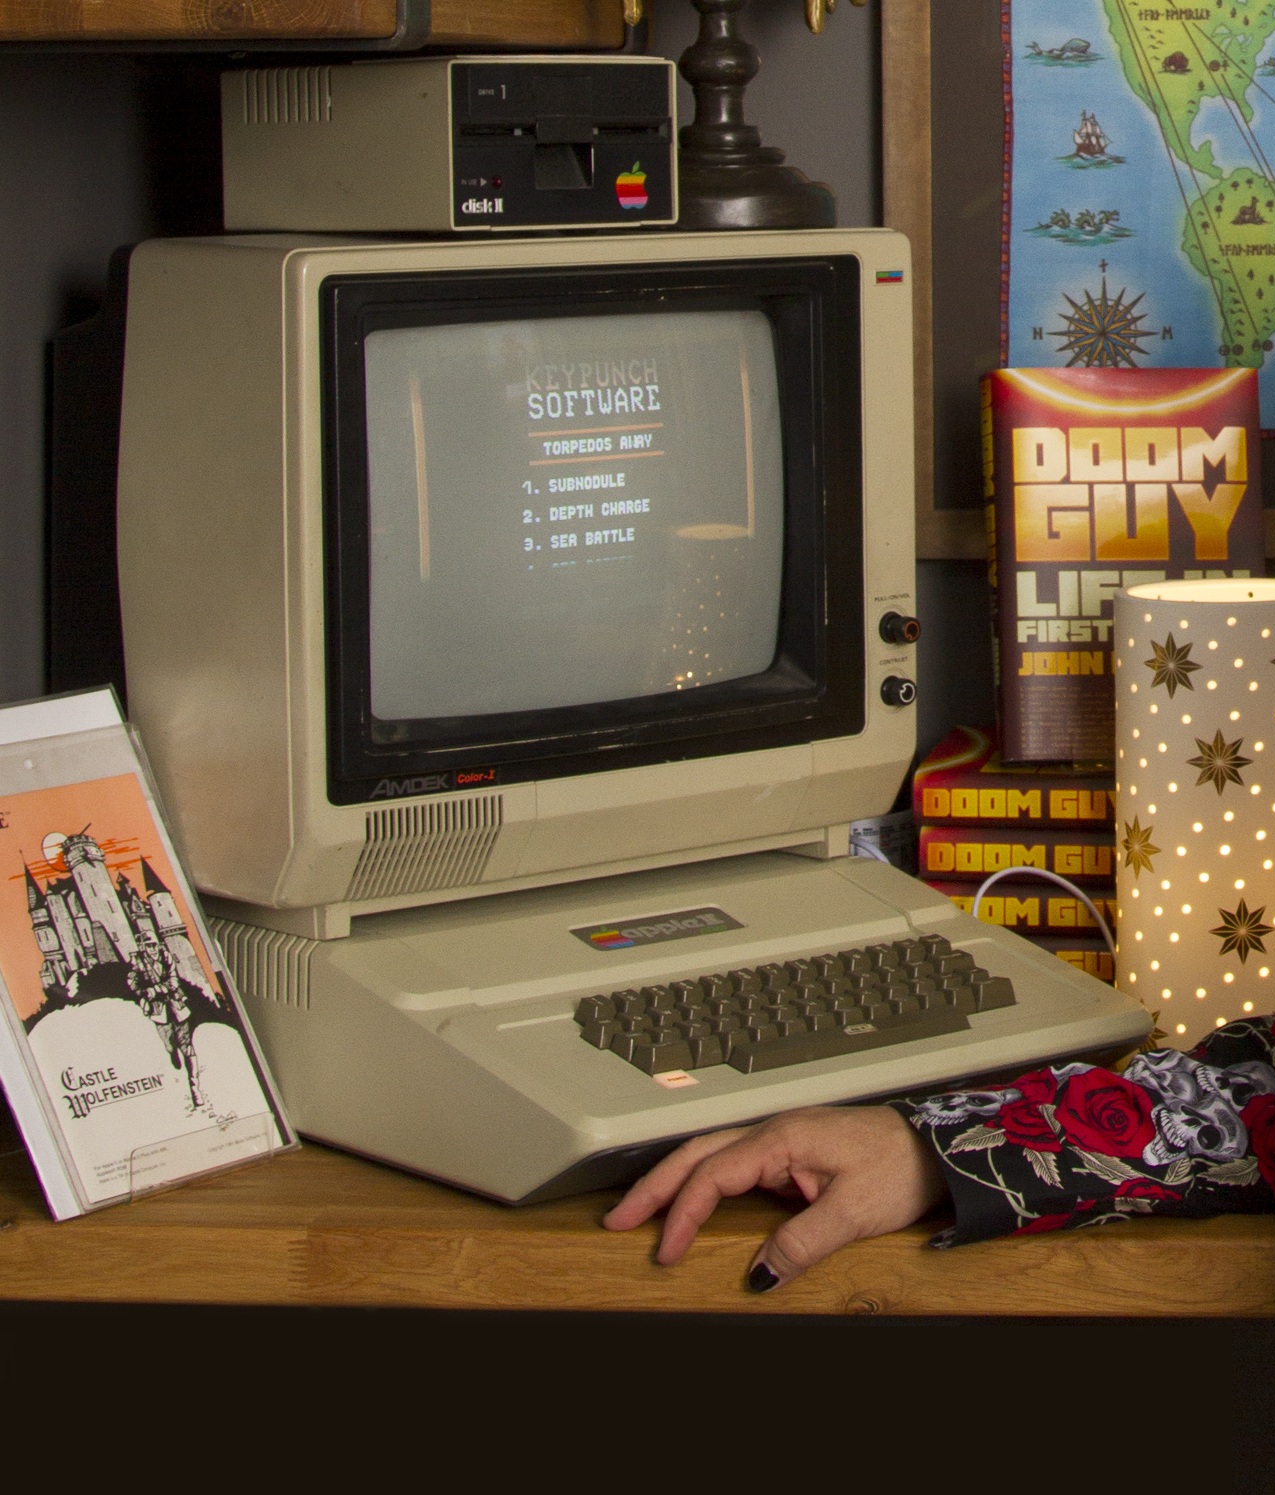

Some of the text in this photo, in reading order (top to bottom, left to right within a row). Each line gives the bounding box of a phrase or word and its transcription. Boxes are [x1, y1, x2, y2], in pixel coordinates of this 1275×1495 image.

[461, 198, 493, 214] disk
[525, 358, 658, 392] KEYPUNCH
[527, 385, 661, 420] SOFTWARE
[543, 433, 653, 456] TORPEDOS AWAY
[1012, 426, 1248, 483] DOOM
[523, 498, 651, 524] 2. DEPTH CHARGE
[1014, 483, 1248, 562] GUY
[523, 527, 636, 551] 3. SEA BATTLE
[1016, 620, 1114, 643] FIRST
[1018, 651, 1104, 676] JOHN
[369, 773, 449, 798] AMDEK
[922, 788, 1042, 818] DOOM
[927, 842, 1046, 872] DOOM
[61, 1066, 118, 1092] CASTLE
